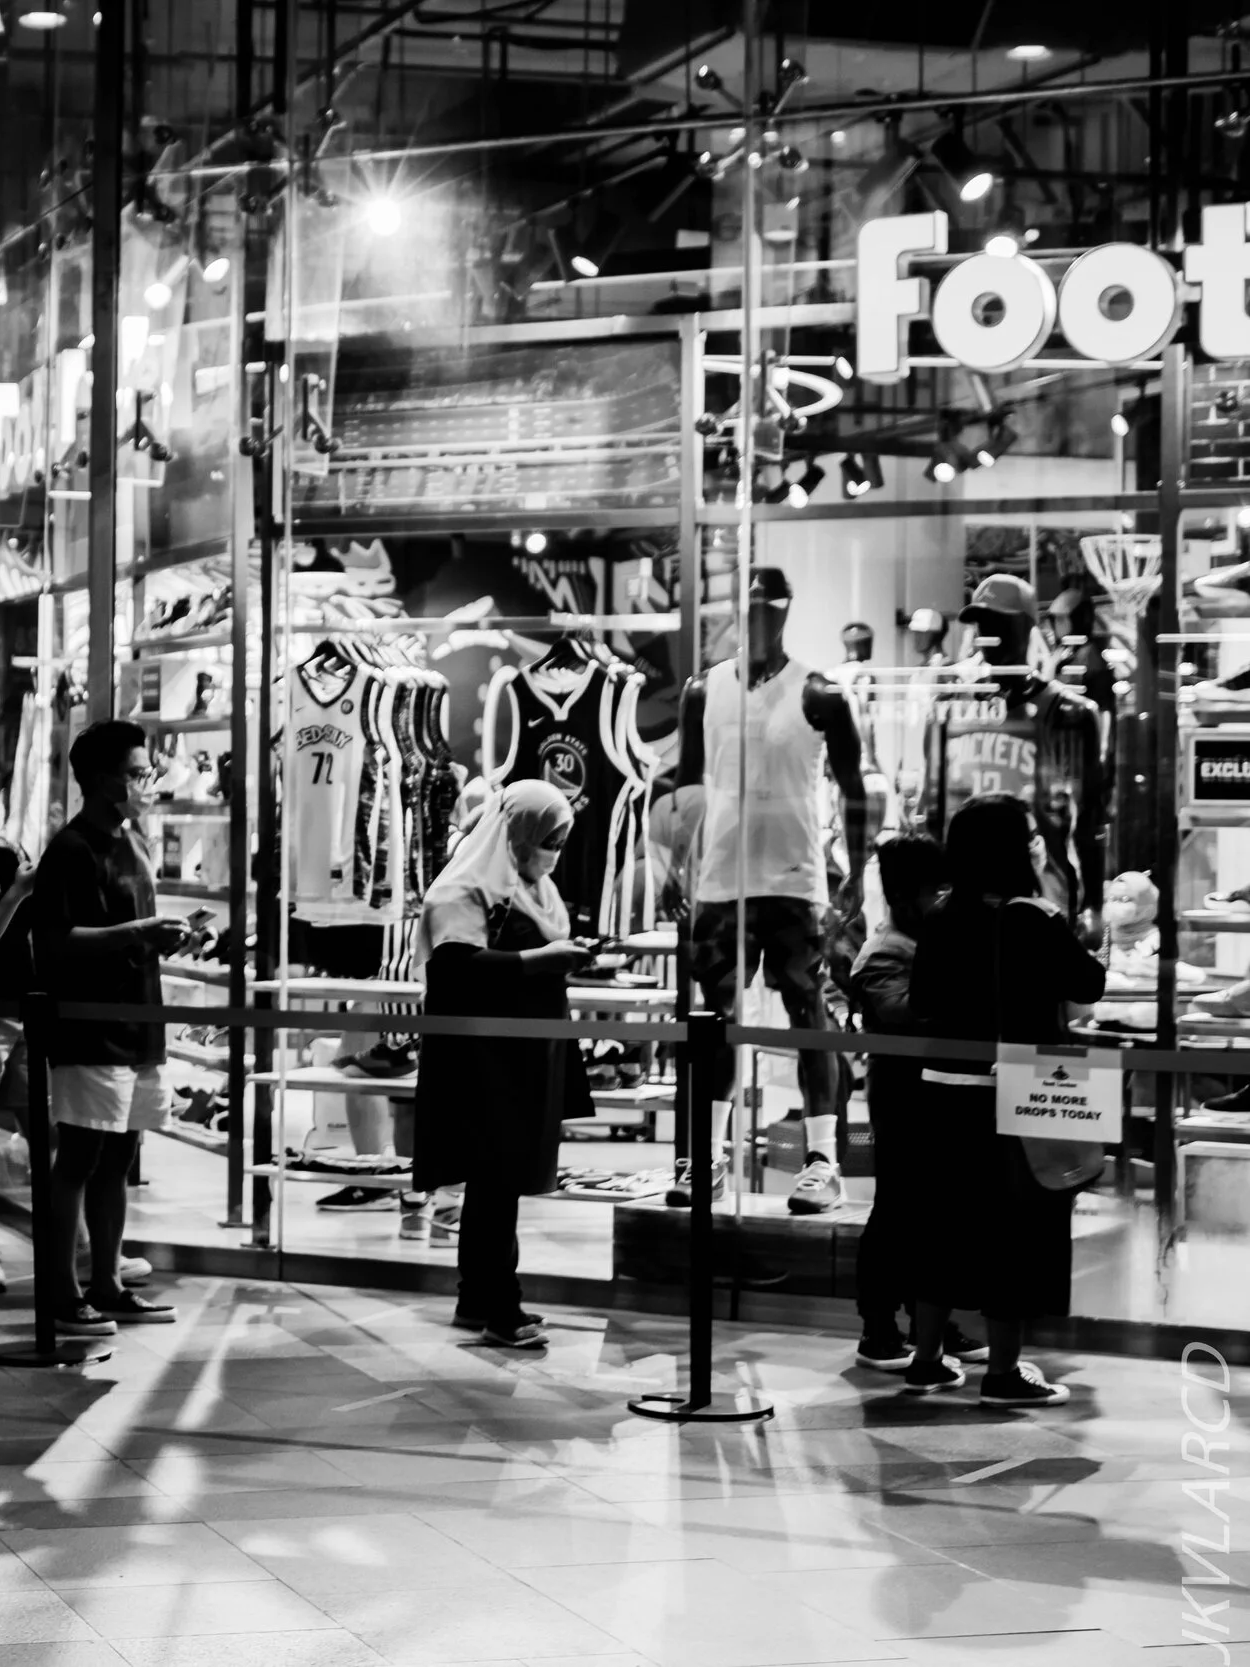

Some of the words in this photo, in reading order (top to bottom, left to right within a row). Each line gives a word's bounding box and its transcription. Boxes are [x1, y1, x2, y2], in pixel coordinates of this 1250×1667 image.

[311, 752, 334, 785] 72
[554, 753, 575, 773] 30
[1029, 1093, 1048, 1104] NO
[1051, 1095, 1088, 1106] MORE
[1015, 1106, 1057, 1118] DROPS
[1061, 1108, 1102, 1121] TODAY
